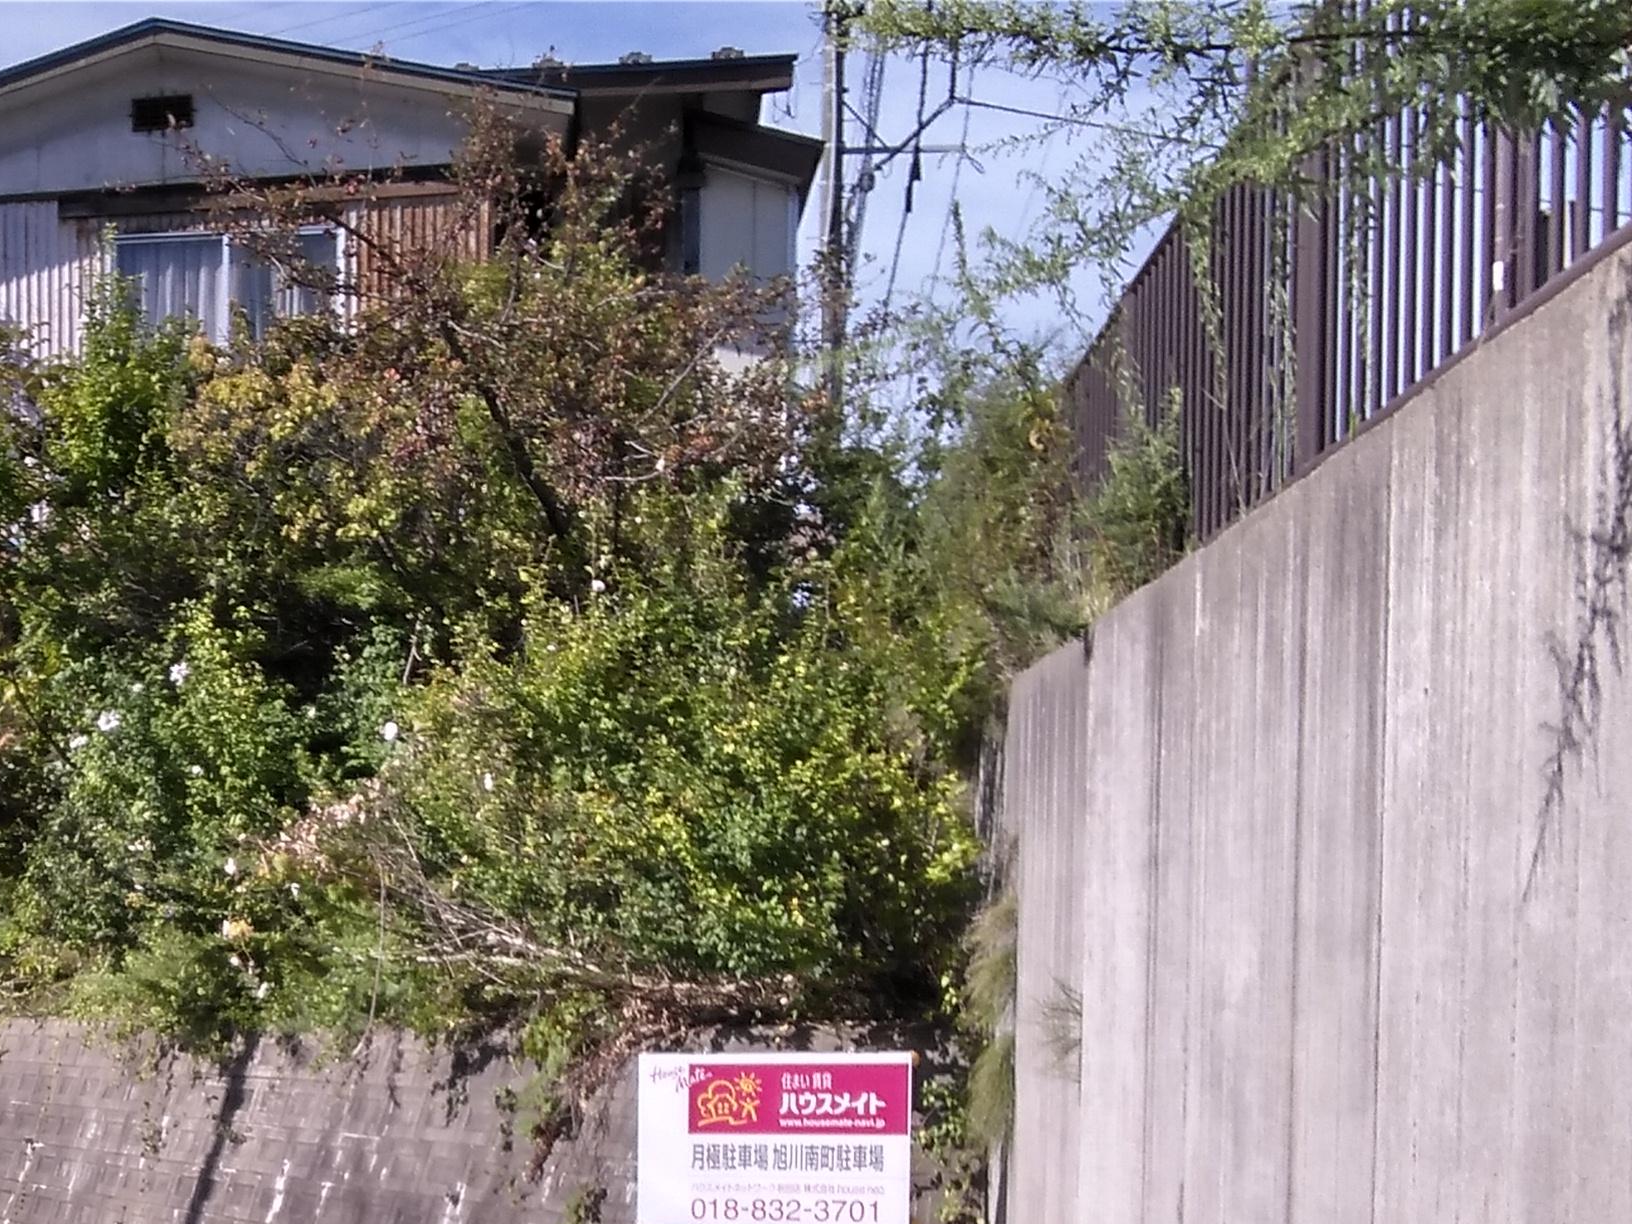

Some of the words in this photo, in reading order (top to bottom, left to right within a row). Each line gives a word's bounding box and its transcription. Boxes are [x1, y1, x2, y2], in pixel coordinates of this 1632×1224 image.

[781, 1071, 810, 1090] 住まい
[779, 1092, 887, 1115] ハウスメイト
[691, 1142, 768, 1171] 月極駐車場
[773, 1142, 884, 1173] 旭川南町駐車場
[691, 1198, 880, 1223] 018-832-3701
